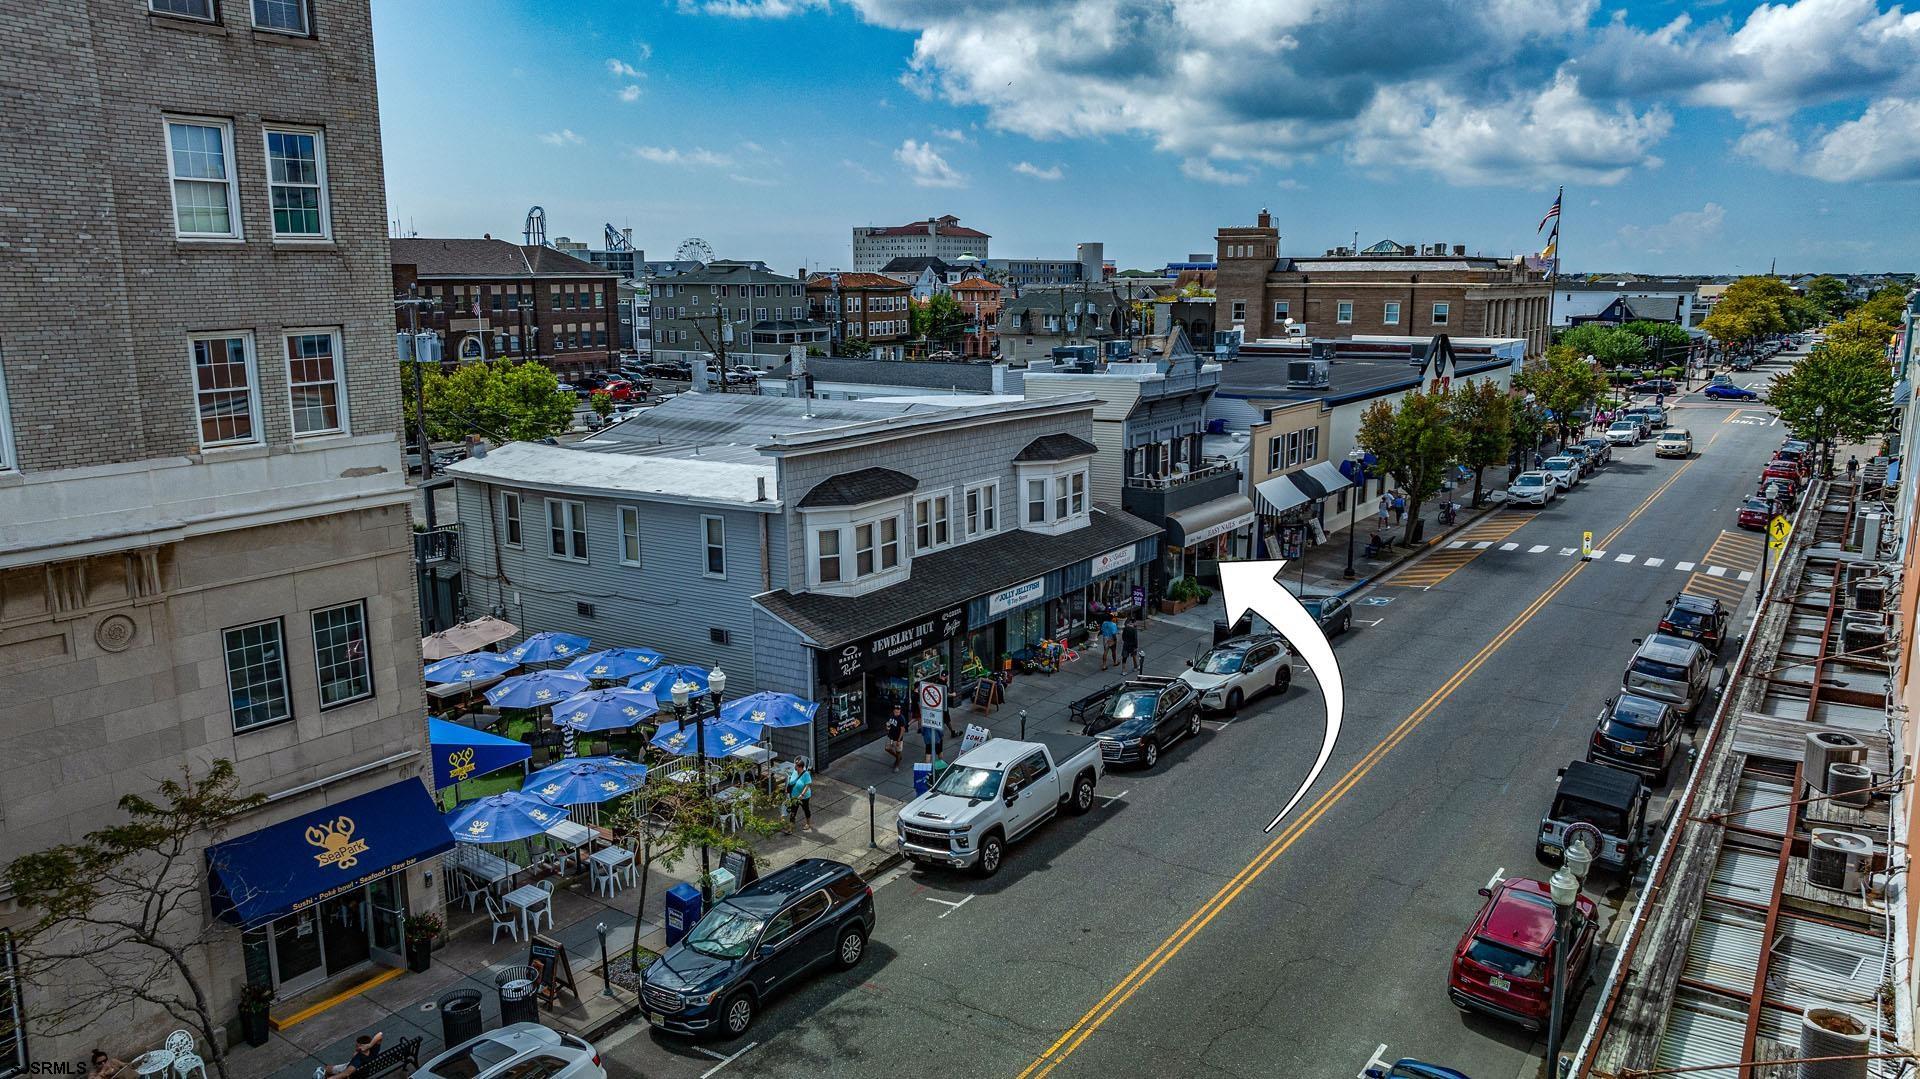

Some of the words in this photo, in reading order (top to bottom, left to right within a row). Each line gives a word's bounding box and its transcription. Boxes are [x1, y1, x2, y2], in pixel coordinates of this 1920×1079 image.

[999, 589, 1015, 601] JOLLY
[1015, 581, 1040, 596] JELLYFISH
[872, 628, 915, 653] JEWELRY
[915, 620, 935, 638] HUT
[838, 652, 863, 664] OAKLEY
[888, 641, 912, 657] Established
[319, 841, 364, 864] SeaPark
[292, 897, 313, 910] Sushi
[337, 881, 354, 893] bowl
[359, 868, 386, 884] Seafood
[391, 863, 405, 872] Raw
[406, 857, 417, 866] bar
